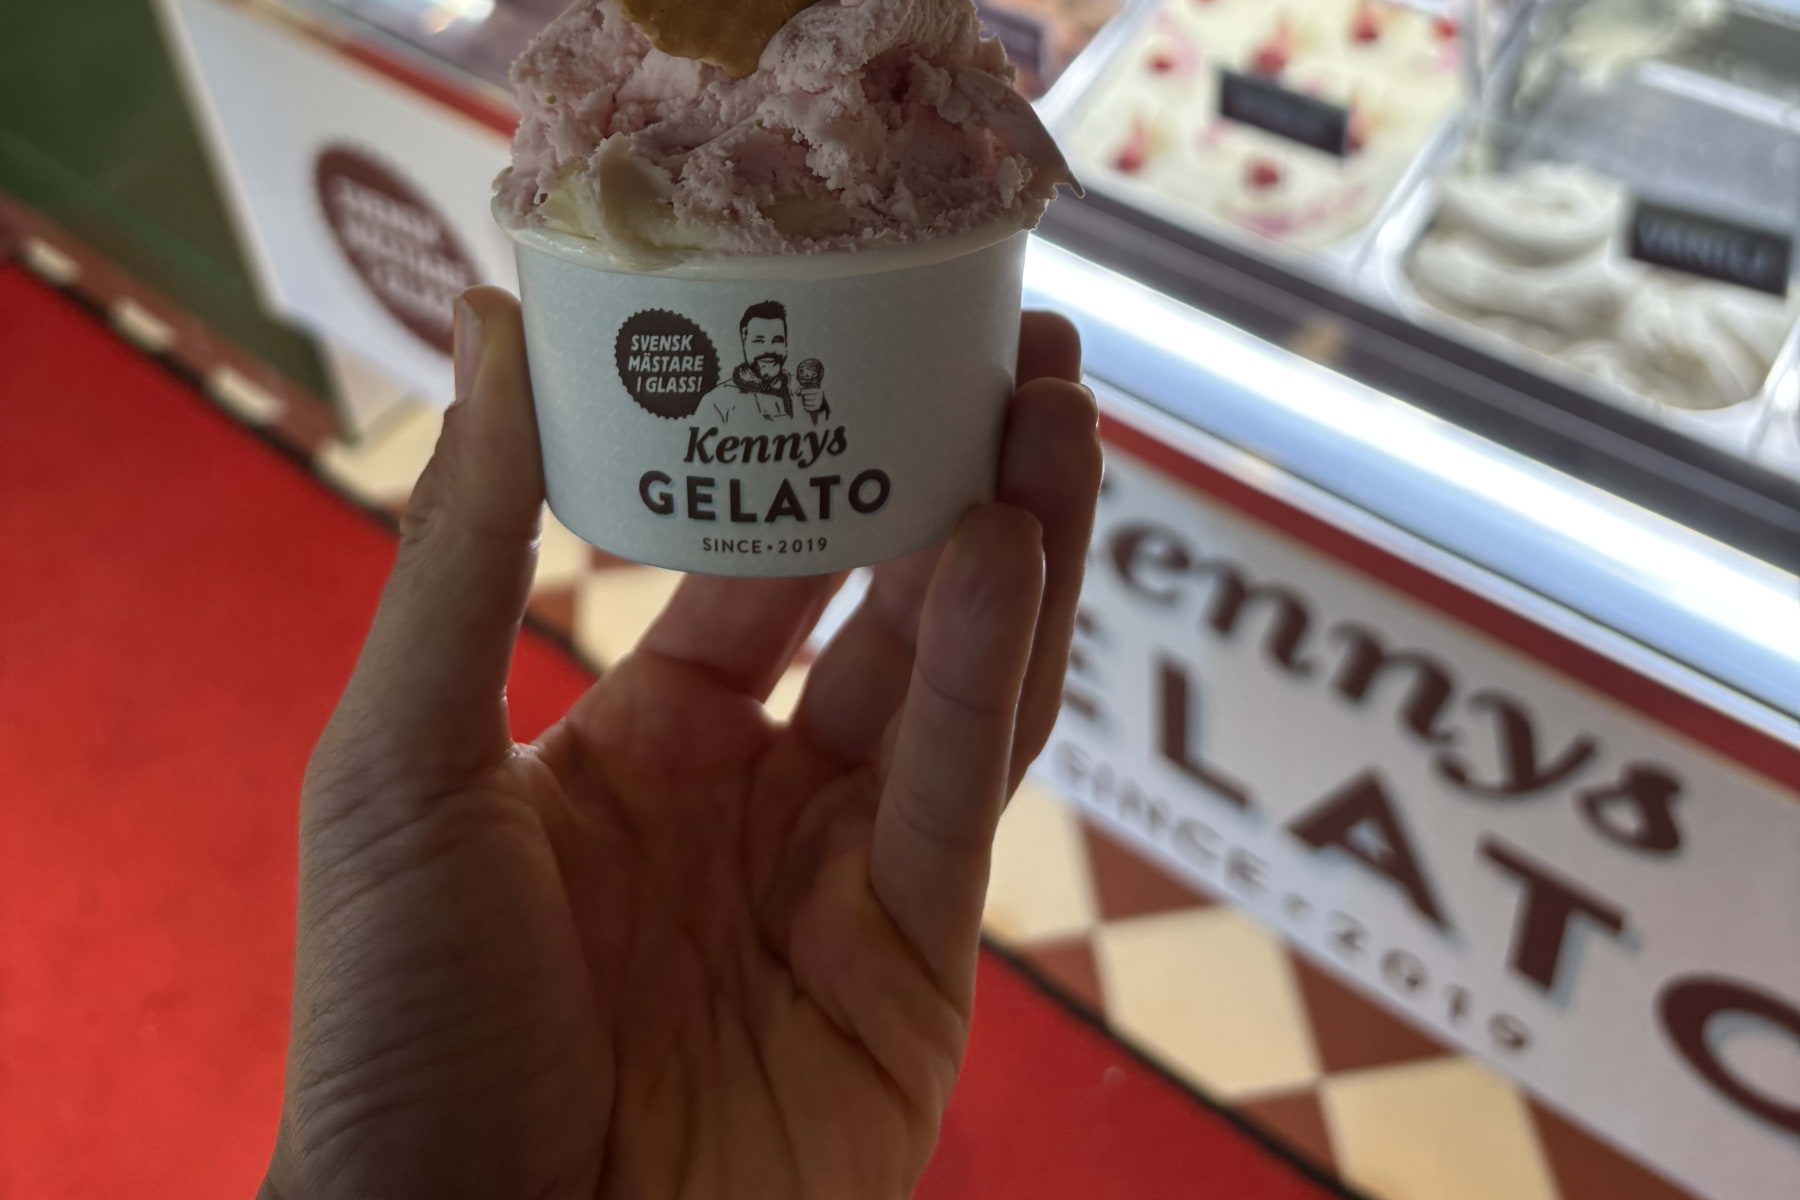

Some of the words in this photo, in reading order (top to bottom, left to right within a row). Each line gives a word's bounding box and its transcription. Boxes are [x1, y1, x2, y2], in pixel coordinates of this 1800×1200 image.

[631, 334, 694, 352] SVENSK
[628, 352, 704, 373] MÄSTARE
[636, 376, 642, 393] I
[645, 375, 703, 393] GLASS!
[683, 424, 848, 469] Kennys
[638, 468, 891, 523] GELATO
[702, 536, 762, 554] SINCE
[778, 537, 828, 554] 2019
[1098, 475, 1687, 862] ennys
[1066, 603, 1800, 1142] LATO
